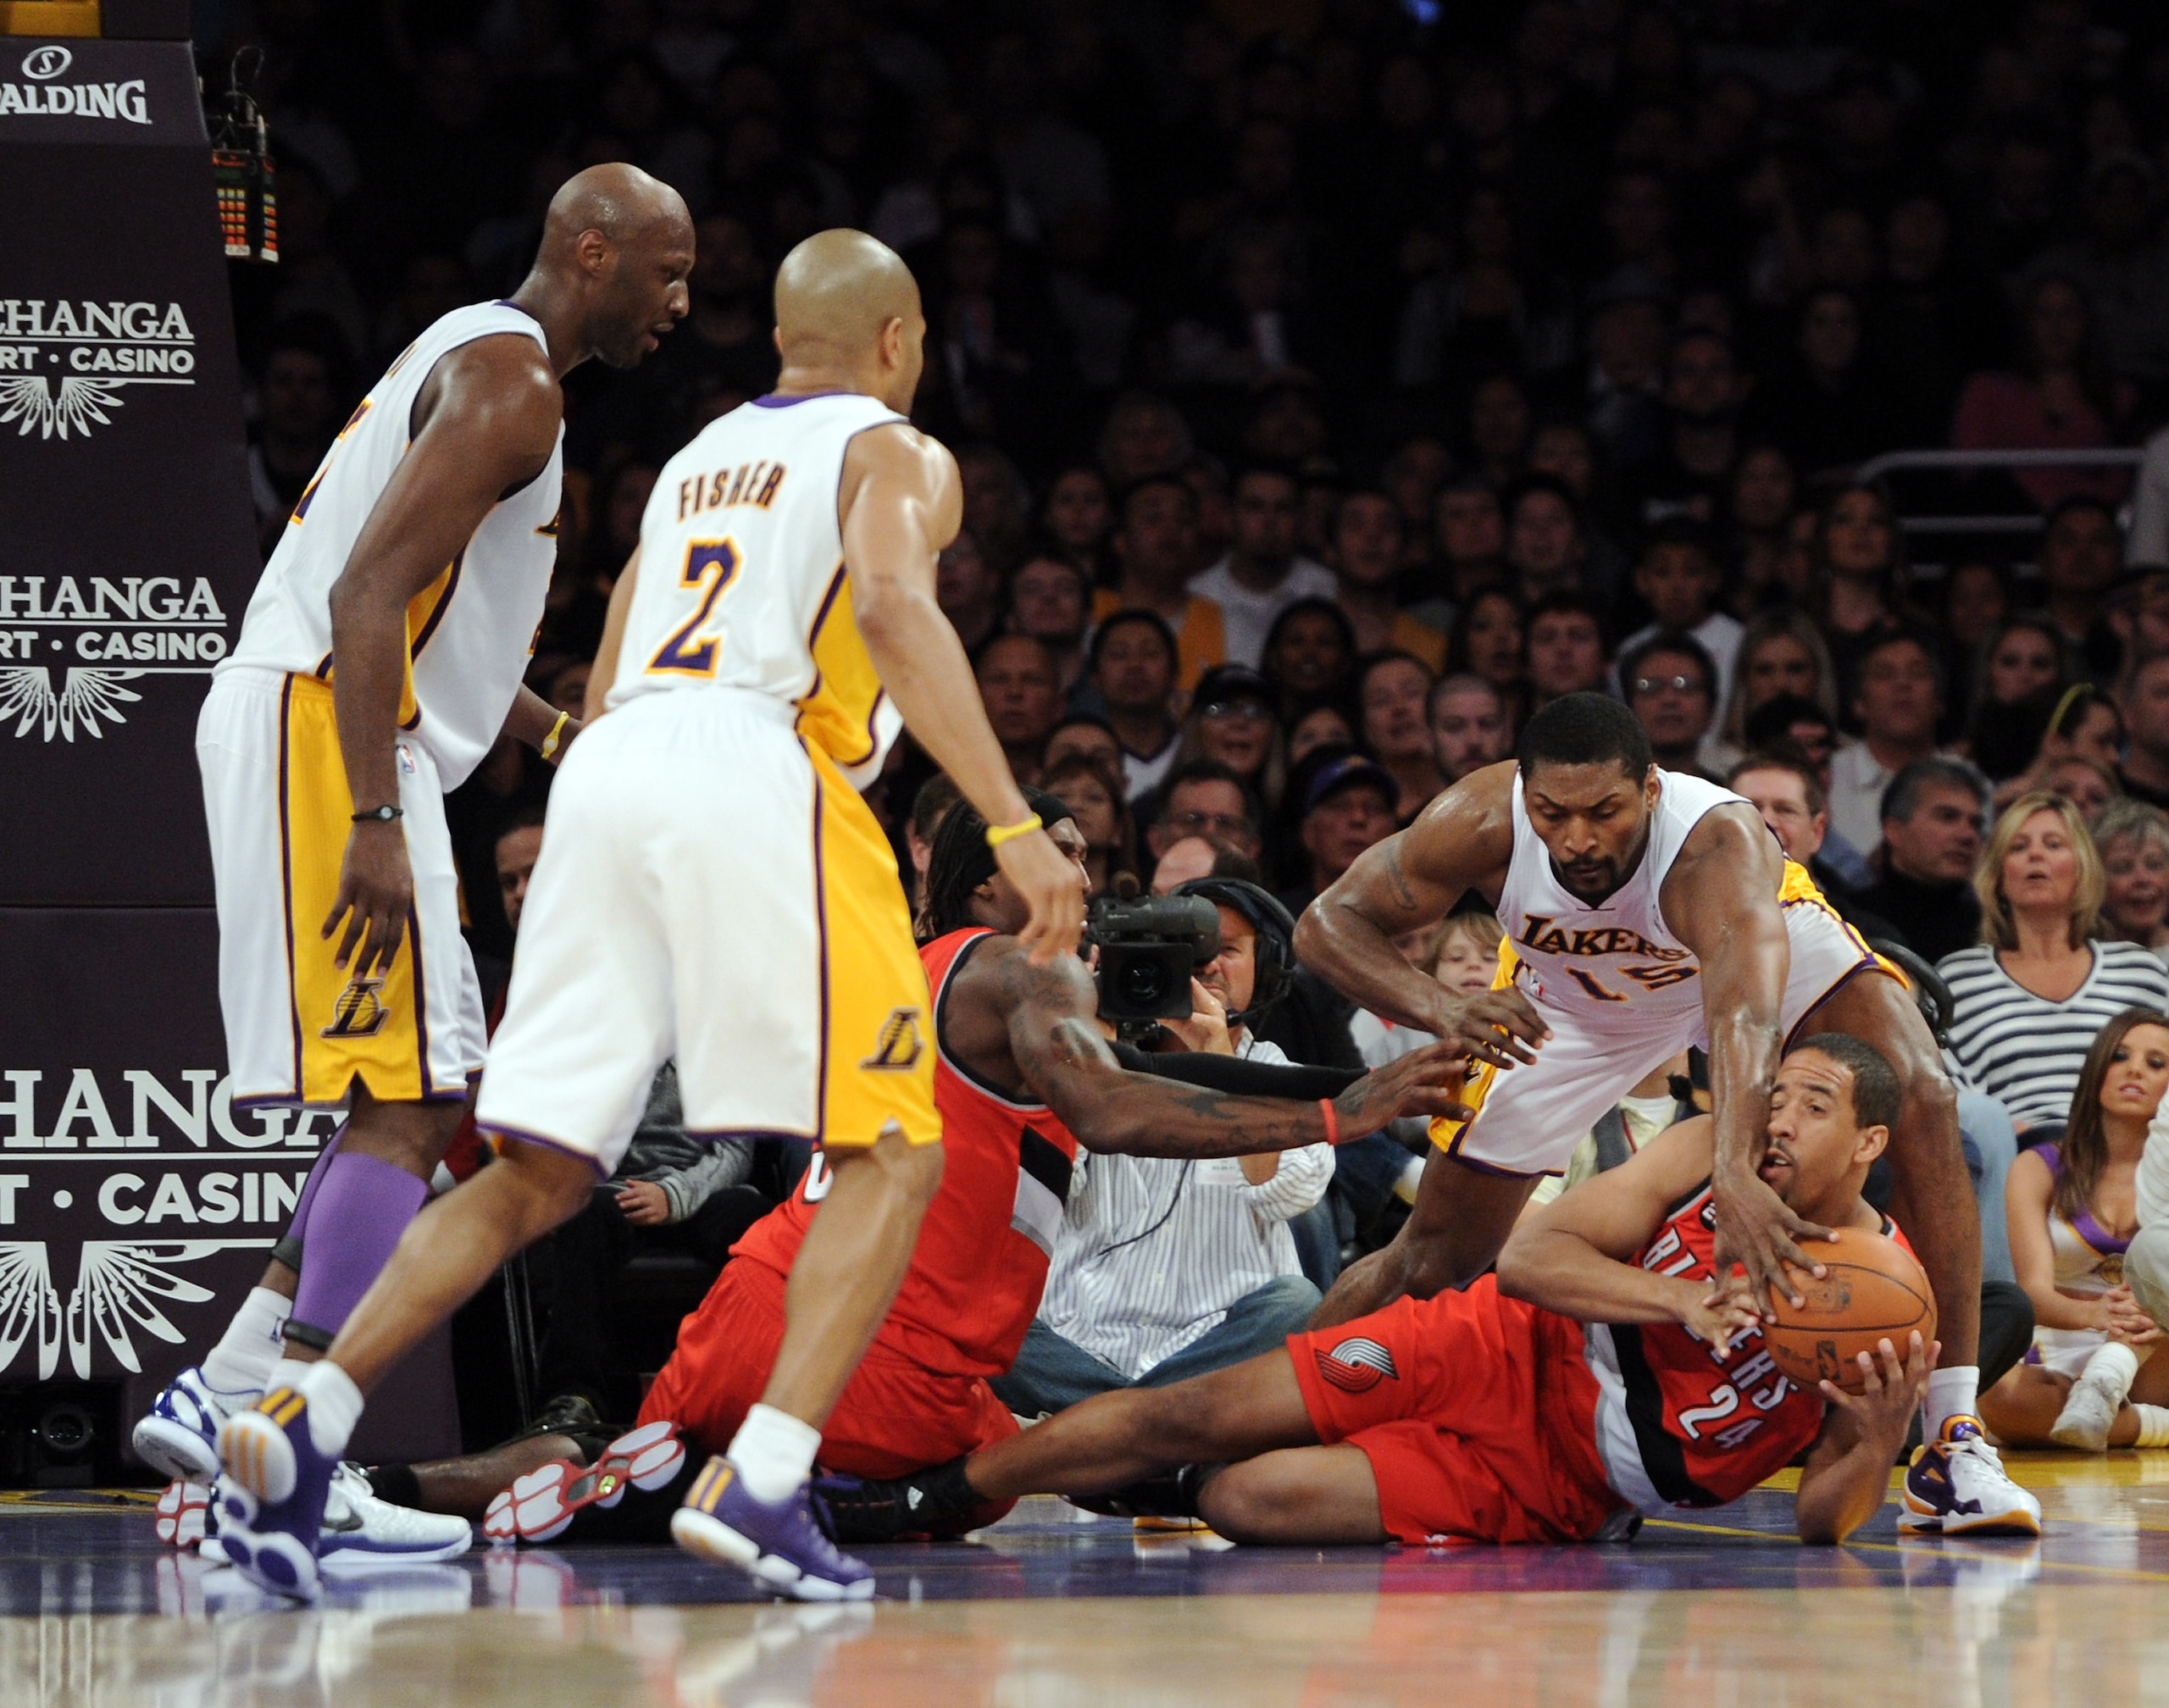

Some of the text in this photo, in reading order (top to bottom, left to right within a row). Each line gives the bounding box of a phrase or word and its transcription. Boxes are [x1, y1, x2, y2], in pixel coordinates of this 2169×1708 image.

[0, 80, 147, 125] ALDING
[69, 347, 195, 374] CASINO
[677, 458, 788, 524] FISHER
[644, 535, 744, 679] 2
[75, 631, 227, 660] CASINO
[1515, 913, 1692, 962] LAKERS
[1678, 1384, 1765, 1449] 24
